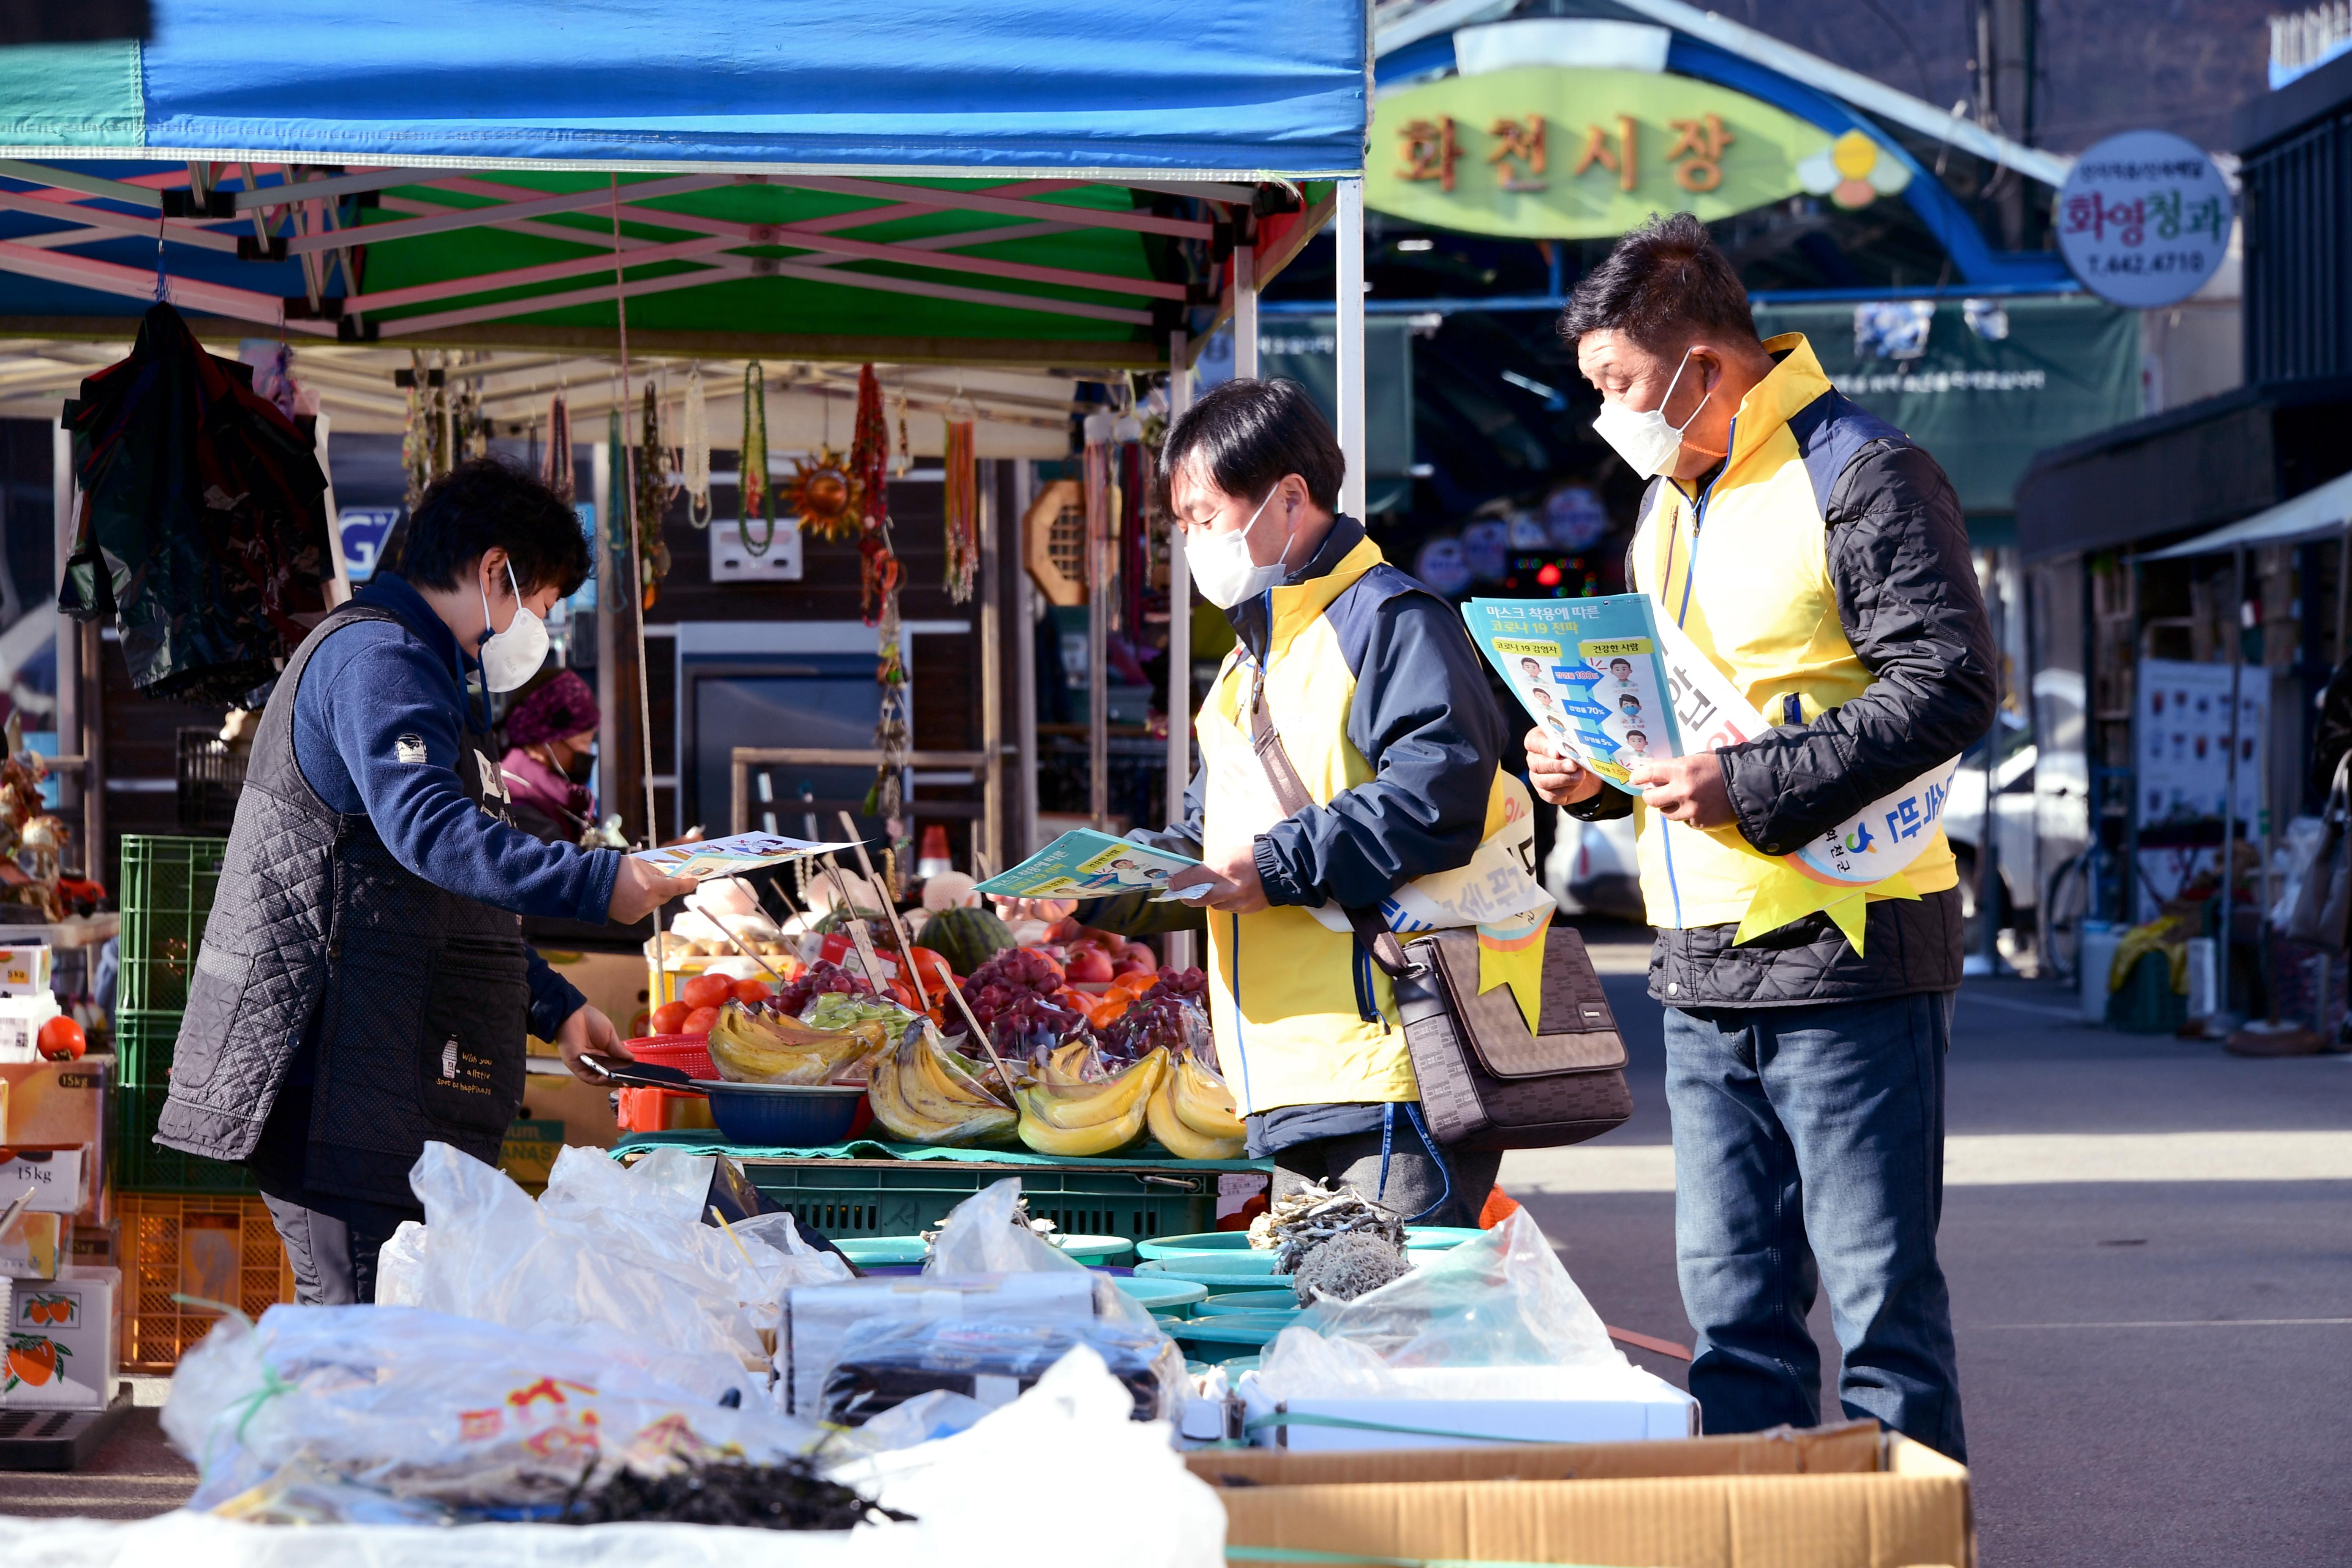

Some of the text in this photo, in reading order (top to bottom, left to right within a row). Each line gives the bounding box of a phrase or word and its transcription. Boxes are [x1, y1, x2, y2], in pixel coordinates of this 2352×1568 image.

[1395, 113, 1734, 192] 화천시장
[1486, 606, 1600, 621] 마스크 착용에 따른
[1491, 620, 1578, 635] 코로나 19 전파
[1497, 642, 1519, 651] 코로나
[1593, 643, 1638, 653] 건강한 사람
[1576, 672, 1599, 680] 100%
[1587, 707, 1605, 715] 70%
[1601, 739, 1613, 747] 5%
[1087, 849, 1120, 868] 건강한 사람
[990, 850, 1070, 887] 마스크 착용에 따른
[62, 1075, 88, 1087] 15kg
[17, 1166, 52, 1183] 15kg
